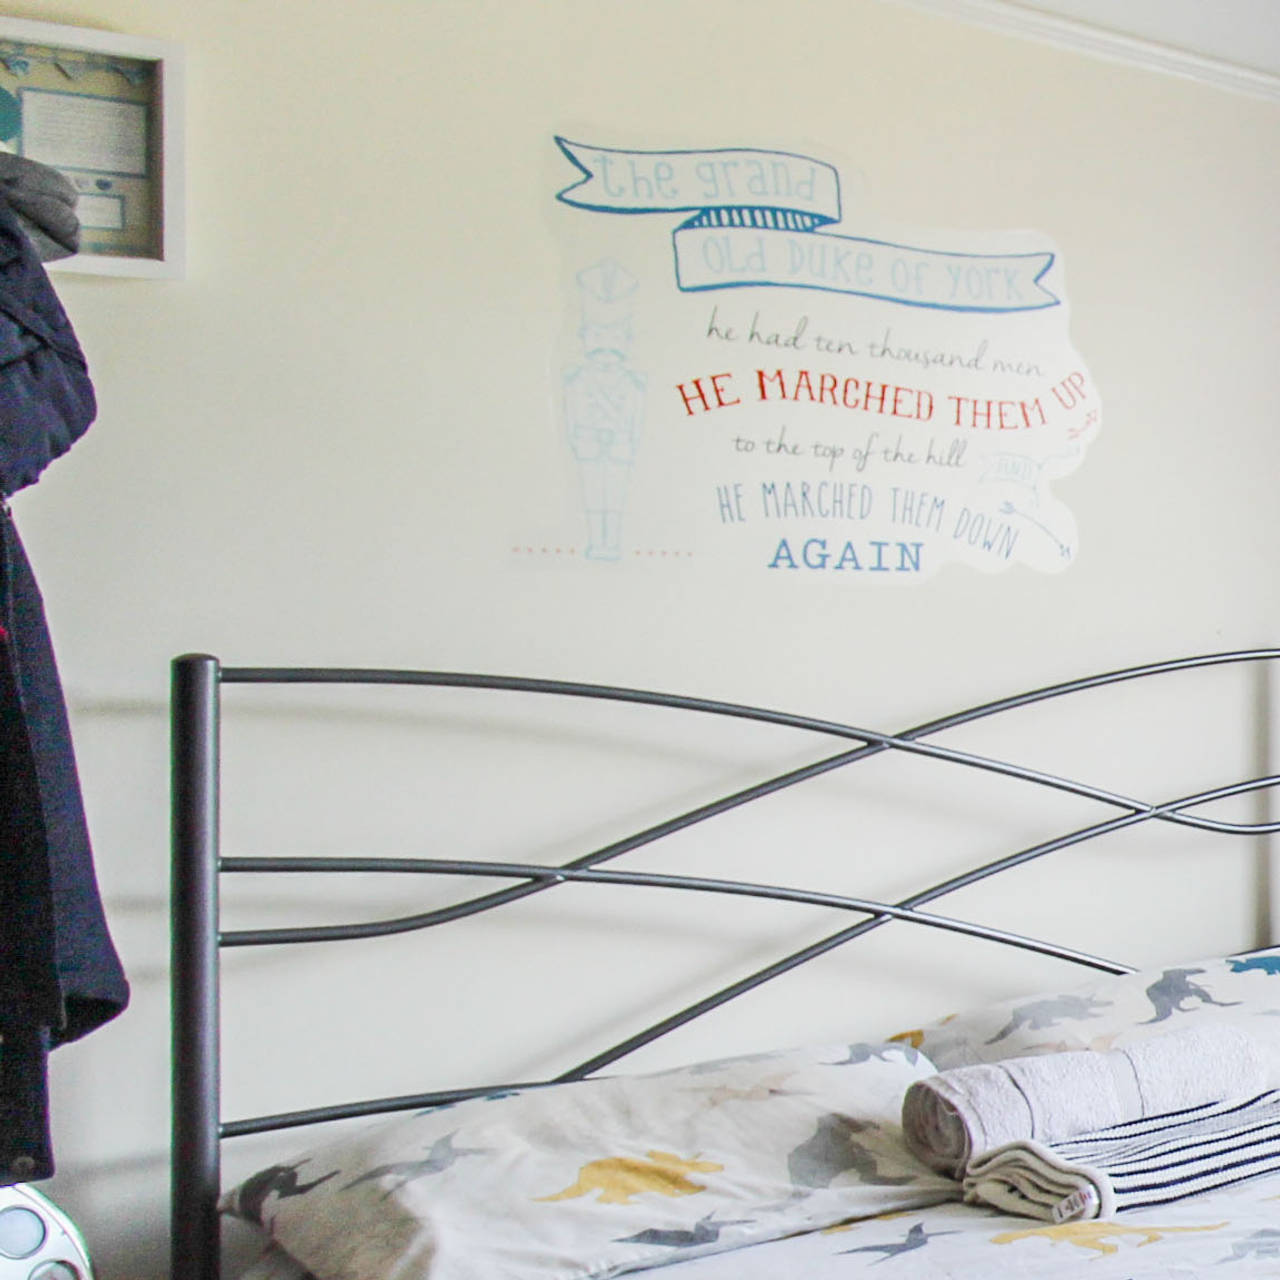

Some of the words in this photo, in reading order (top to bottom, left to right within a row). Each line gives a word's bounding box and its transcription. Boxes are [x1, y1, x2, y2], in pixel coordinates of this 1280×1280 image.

[592, 154, 679, 200] the
[695, 158, 817, 201] grand
[705, 305, 736, 341] he
[748, 308, 809, 350] had
[815, 334, 856, 356] ten
[868, 328, 988, 372] thousand
[991, 357, 1043, 377] men
[676, 373, 741, 416] HE
[755, 369, 933, 422] MARCHED
[947, 395, 1047, 430] THEM
[1052, 371, 1086, 411] UP
[732, 436, 755, 453] to
[765, 426, 802, 456] the
[813, 441, 845, 473] top
[852, 432, 878, 473] of
[884, 434, 918, 464] the
[925, 437, 968, 468] hill
[716, 483, 746, 524] HE
[761, 480, 873, 520] MARCHED
[891, 486, 946, 532] THEM
[953, 507, 1020, 560] DOWN
[767, 538, 925, 572] AGAIN
